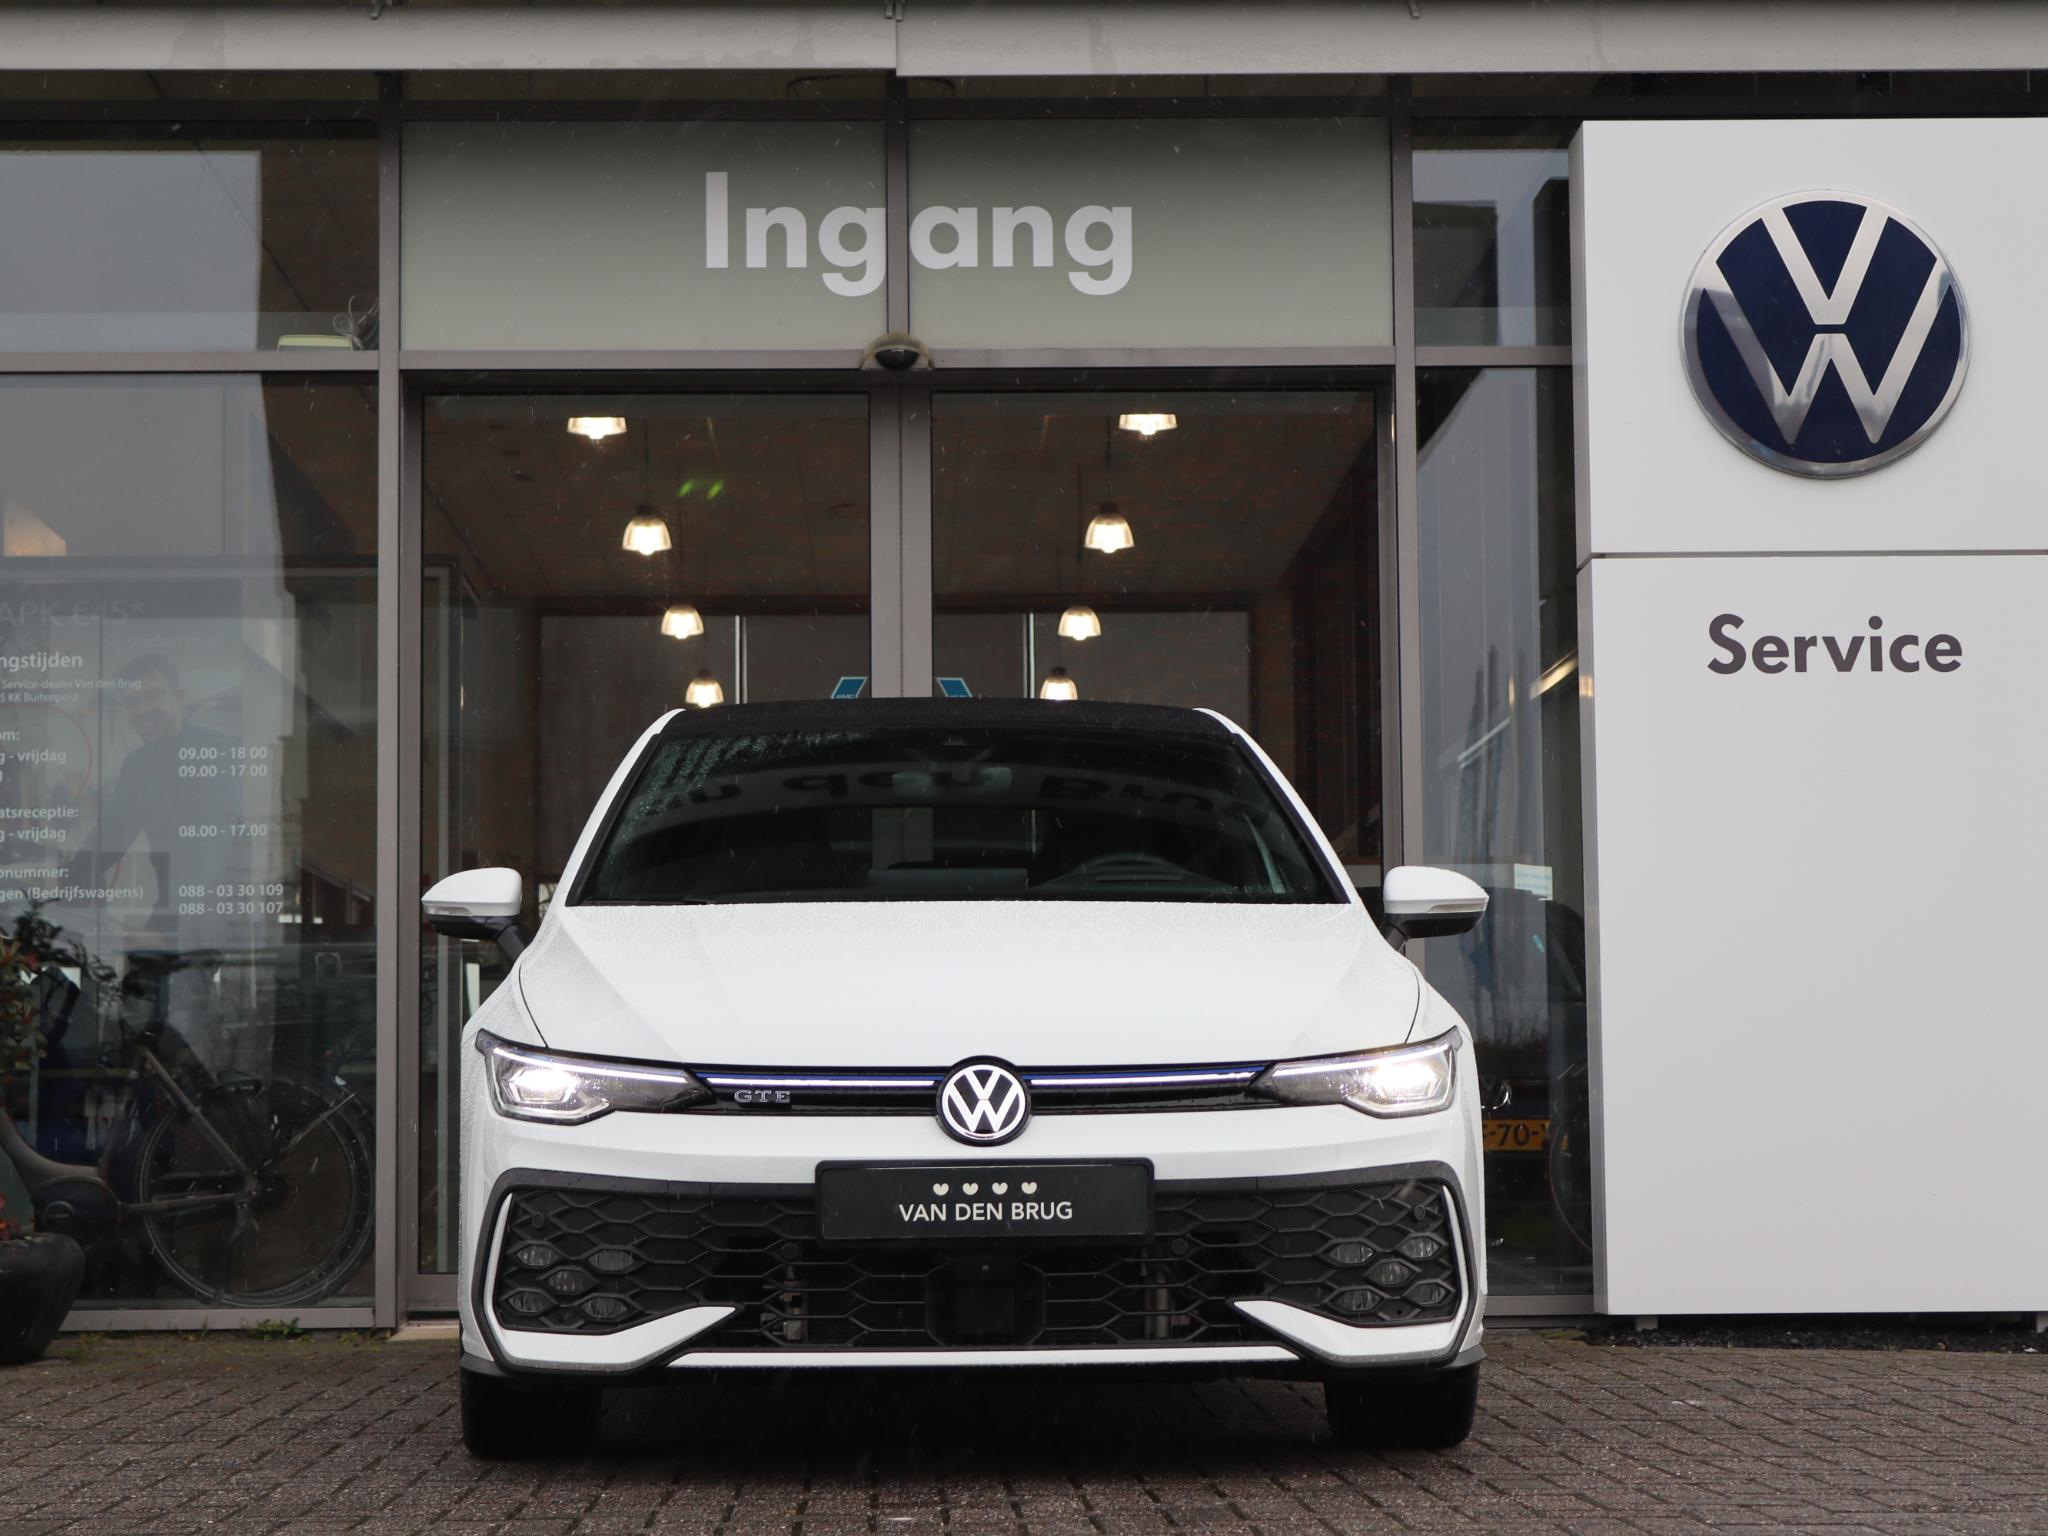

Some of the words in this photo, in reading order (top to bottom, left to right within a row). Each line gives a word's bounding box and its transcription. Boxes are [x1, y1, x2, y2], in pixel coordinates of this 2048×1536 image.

[706, 172, 1132, 297] Ingang
[1707, 613, 1963, 675] Service
[8, 692, 23, 703] KK
[17, 748, 67, 766] vrijdag
[179, 746, 218, 760] 09.00
[230, 746, 268, 759] 1800
[179, 764, 218, 777] 09.00
[230, 764, 268, 777] 1700
[17, 826, 67, 843] vrijdag
[179, 824, 218, 838] 08.00
[230, 824, 268, 837] 17.00
[27, 885, 144, 902] (Bedrijfswagens)
[178, 884, 205, 897] 088
[216, 884, 234, 897] 03
[237, 884, 255, 897] 30
[259, 884, 284, 897] 109
[178, 902, 205, 915] 088
[216, 902, 234, 915] 03
[237, 902, 255, 915] 30
[259, 902, 284, 915] 107
[734, 1089, 791, 1104] GTE
[899, 1202, 948, 1222] VAN
[955, 1202, 1003, 1222] DEN
[1011, 1201, 1073, 1221] BRUG
